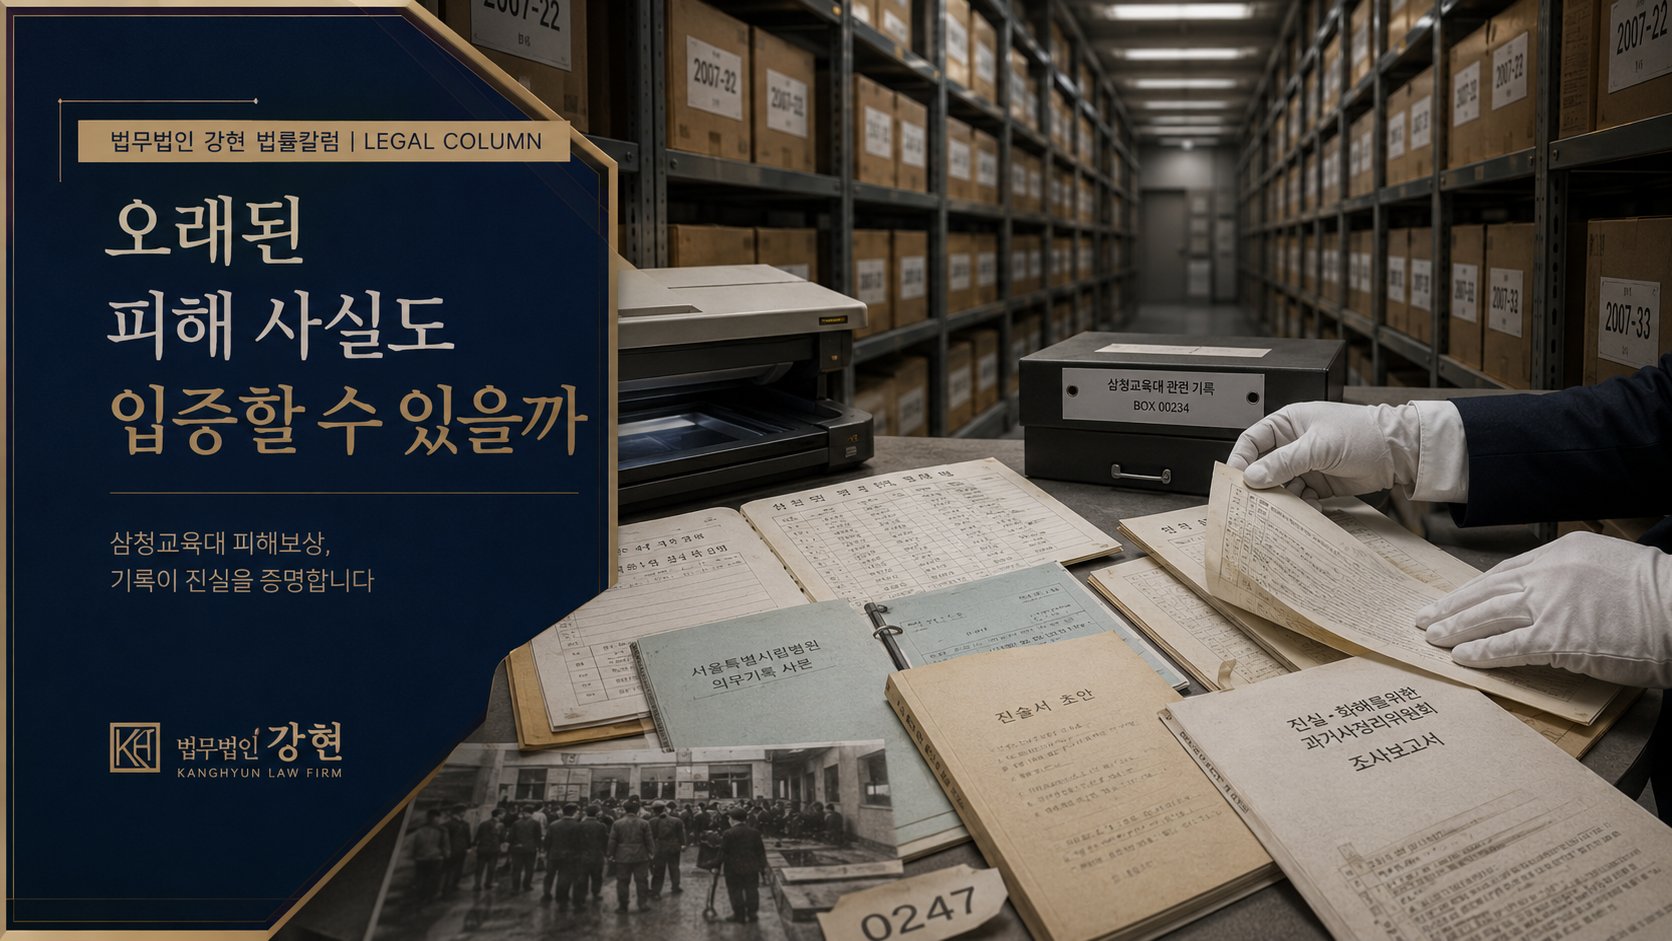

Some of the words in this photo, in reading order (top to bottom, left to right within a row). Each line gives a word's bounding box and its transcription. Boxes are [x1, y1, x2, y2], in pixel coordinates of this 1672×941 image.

[483, 0, 561, 31] 07-22
[1616, 0, 1668, 55] 2007-22
[694, 58, 737, 94] 2007-22
[1605, 301, 1651, 340] 2007-33
[1107, 378, 1164, 394] 삼청교육대
[1167, 380, 1189, 395] 관련
[1133, 400, 1156, 412] BOX
[1158, 401, 1190, 413] 00234
[995, 700, 1052, 724] 진술서
[1060, 688, 1095, 706] 초안
[1300, 701, 1439, 750] 과거사정리위원회
[1348, 731, 1445, 772] 조사보고서
[861, 886, 975, 941] 0247
